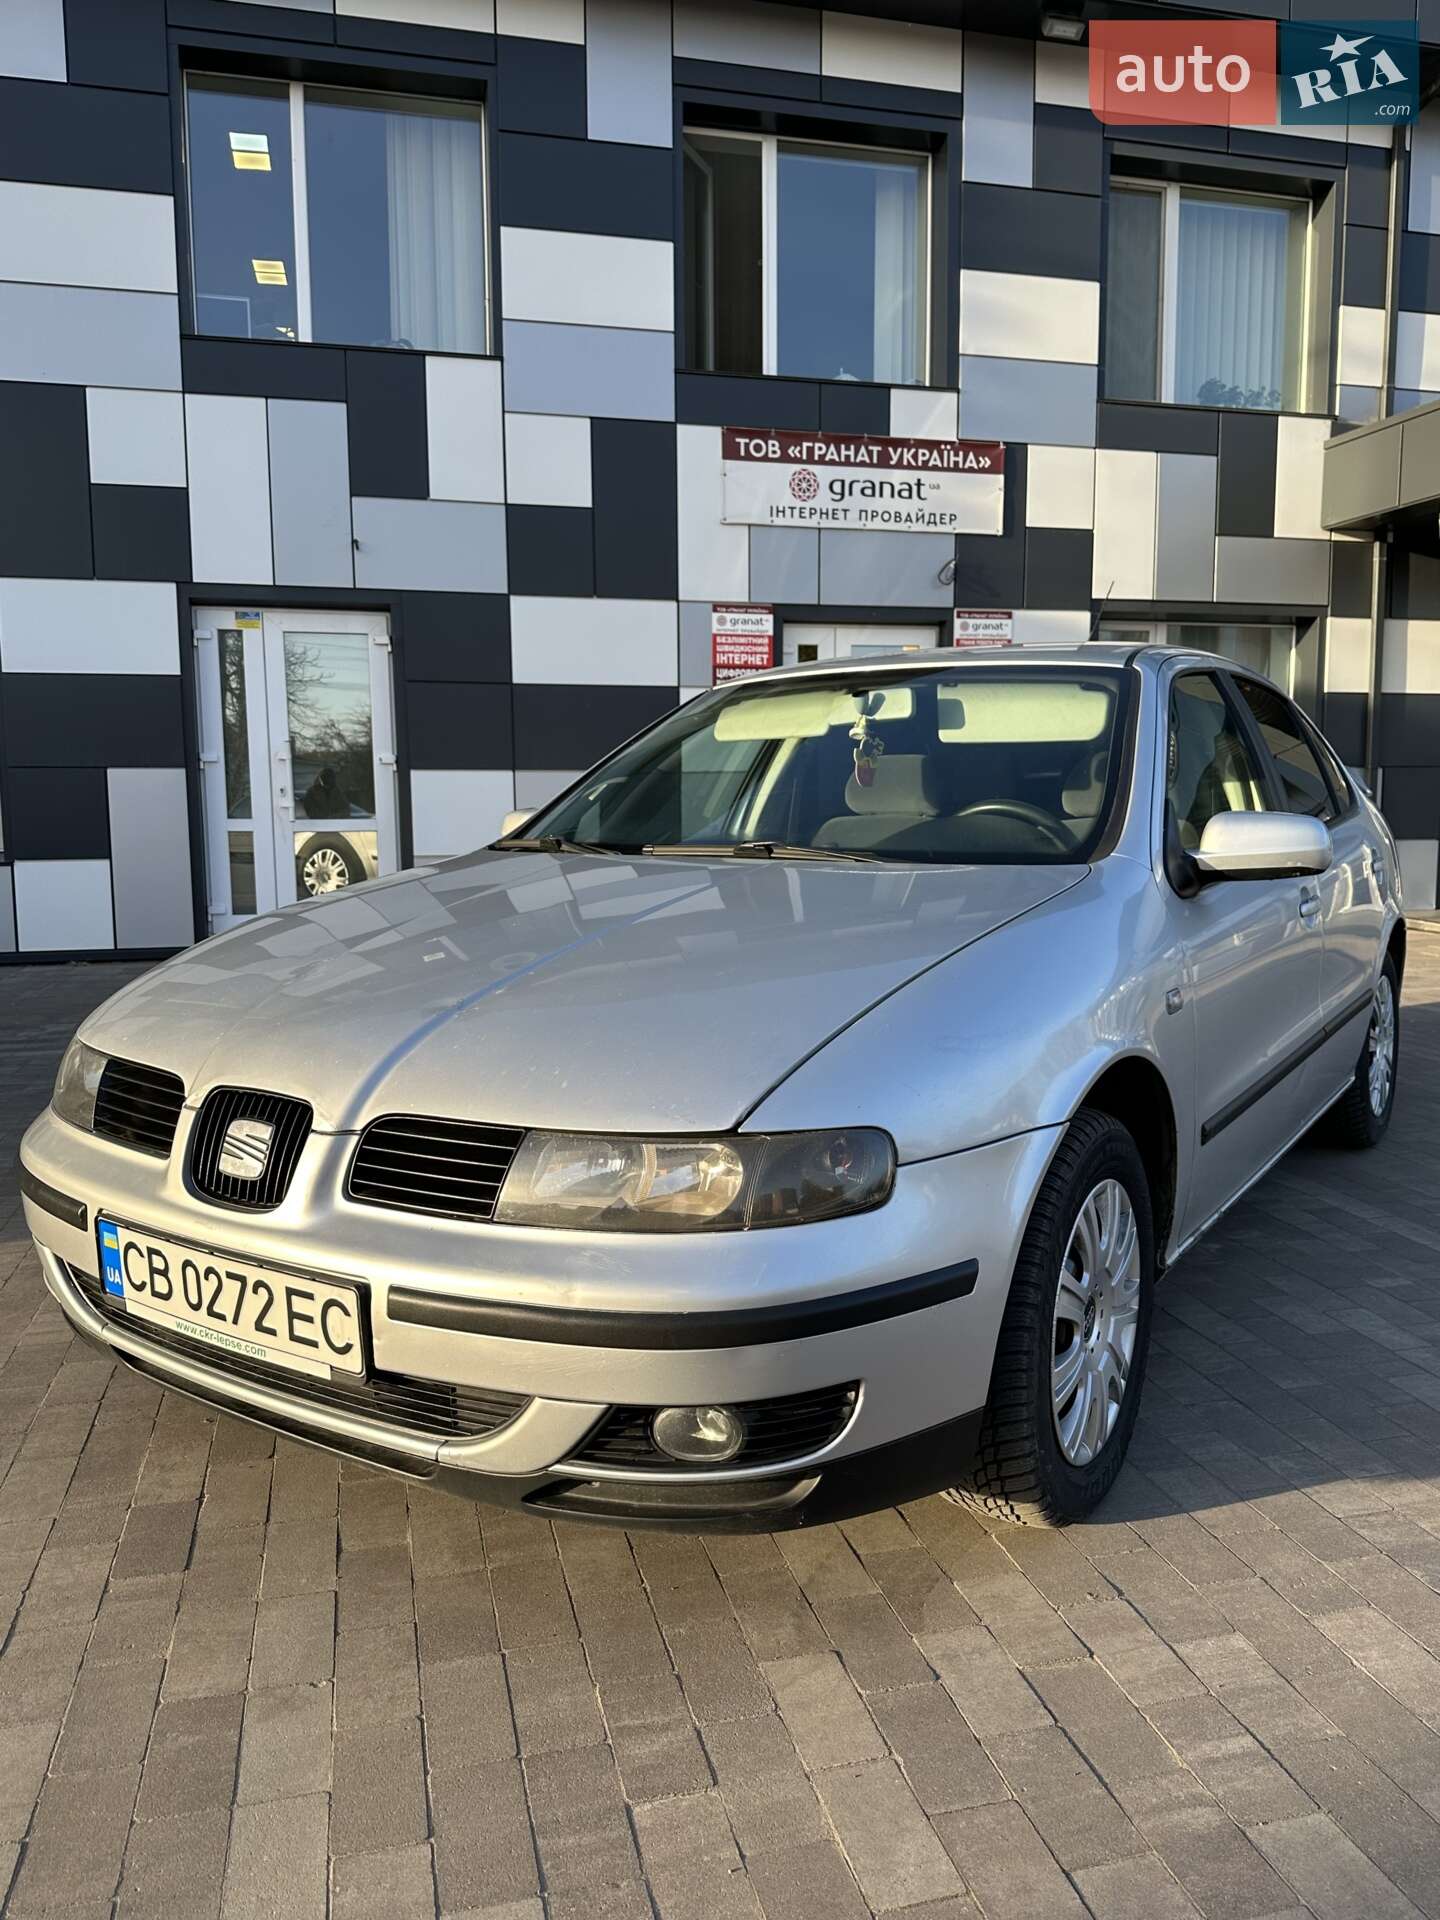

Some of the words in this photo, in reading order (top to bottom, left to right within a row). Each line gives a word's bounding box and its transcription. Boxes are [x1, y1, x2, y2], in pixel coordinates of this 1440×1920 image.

[735, 438, 781, 458] ТОВ
[788, 441, 882, 464] «ГРАНАТ
[888, 444, 991, 470] УКРАЇНА»
[828, 478, 927, 502] granat
[769, 505, 851, 521] ІНТЕРНЕТ
[858, 507, 958, 527] ПРОВАЙДЕР
[729, 617, 765, 627] granat
[971, 622, 1004, 632] granat
[716, 653, 769, 665] ІНТЕРНЕТ
[107, 1266, 122, 1286] UA
[123, 1241, 173, 1301] CB
[181, 1259, 277, 1337] 0272
[285, 1286, 354, 1356] EC
[175, 1319, 267, 1358] www.ckr-lepse.com
